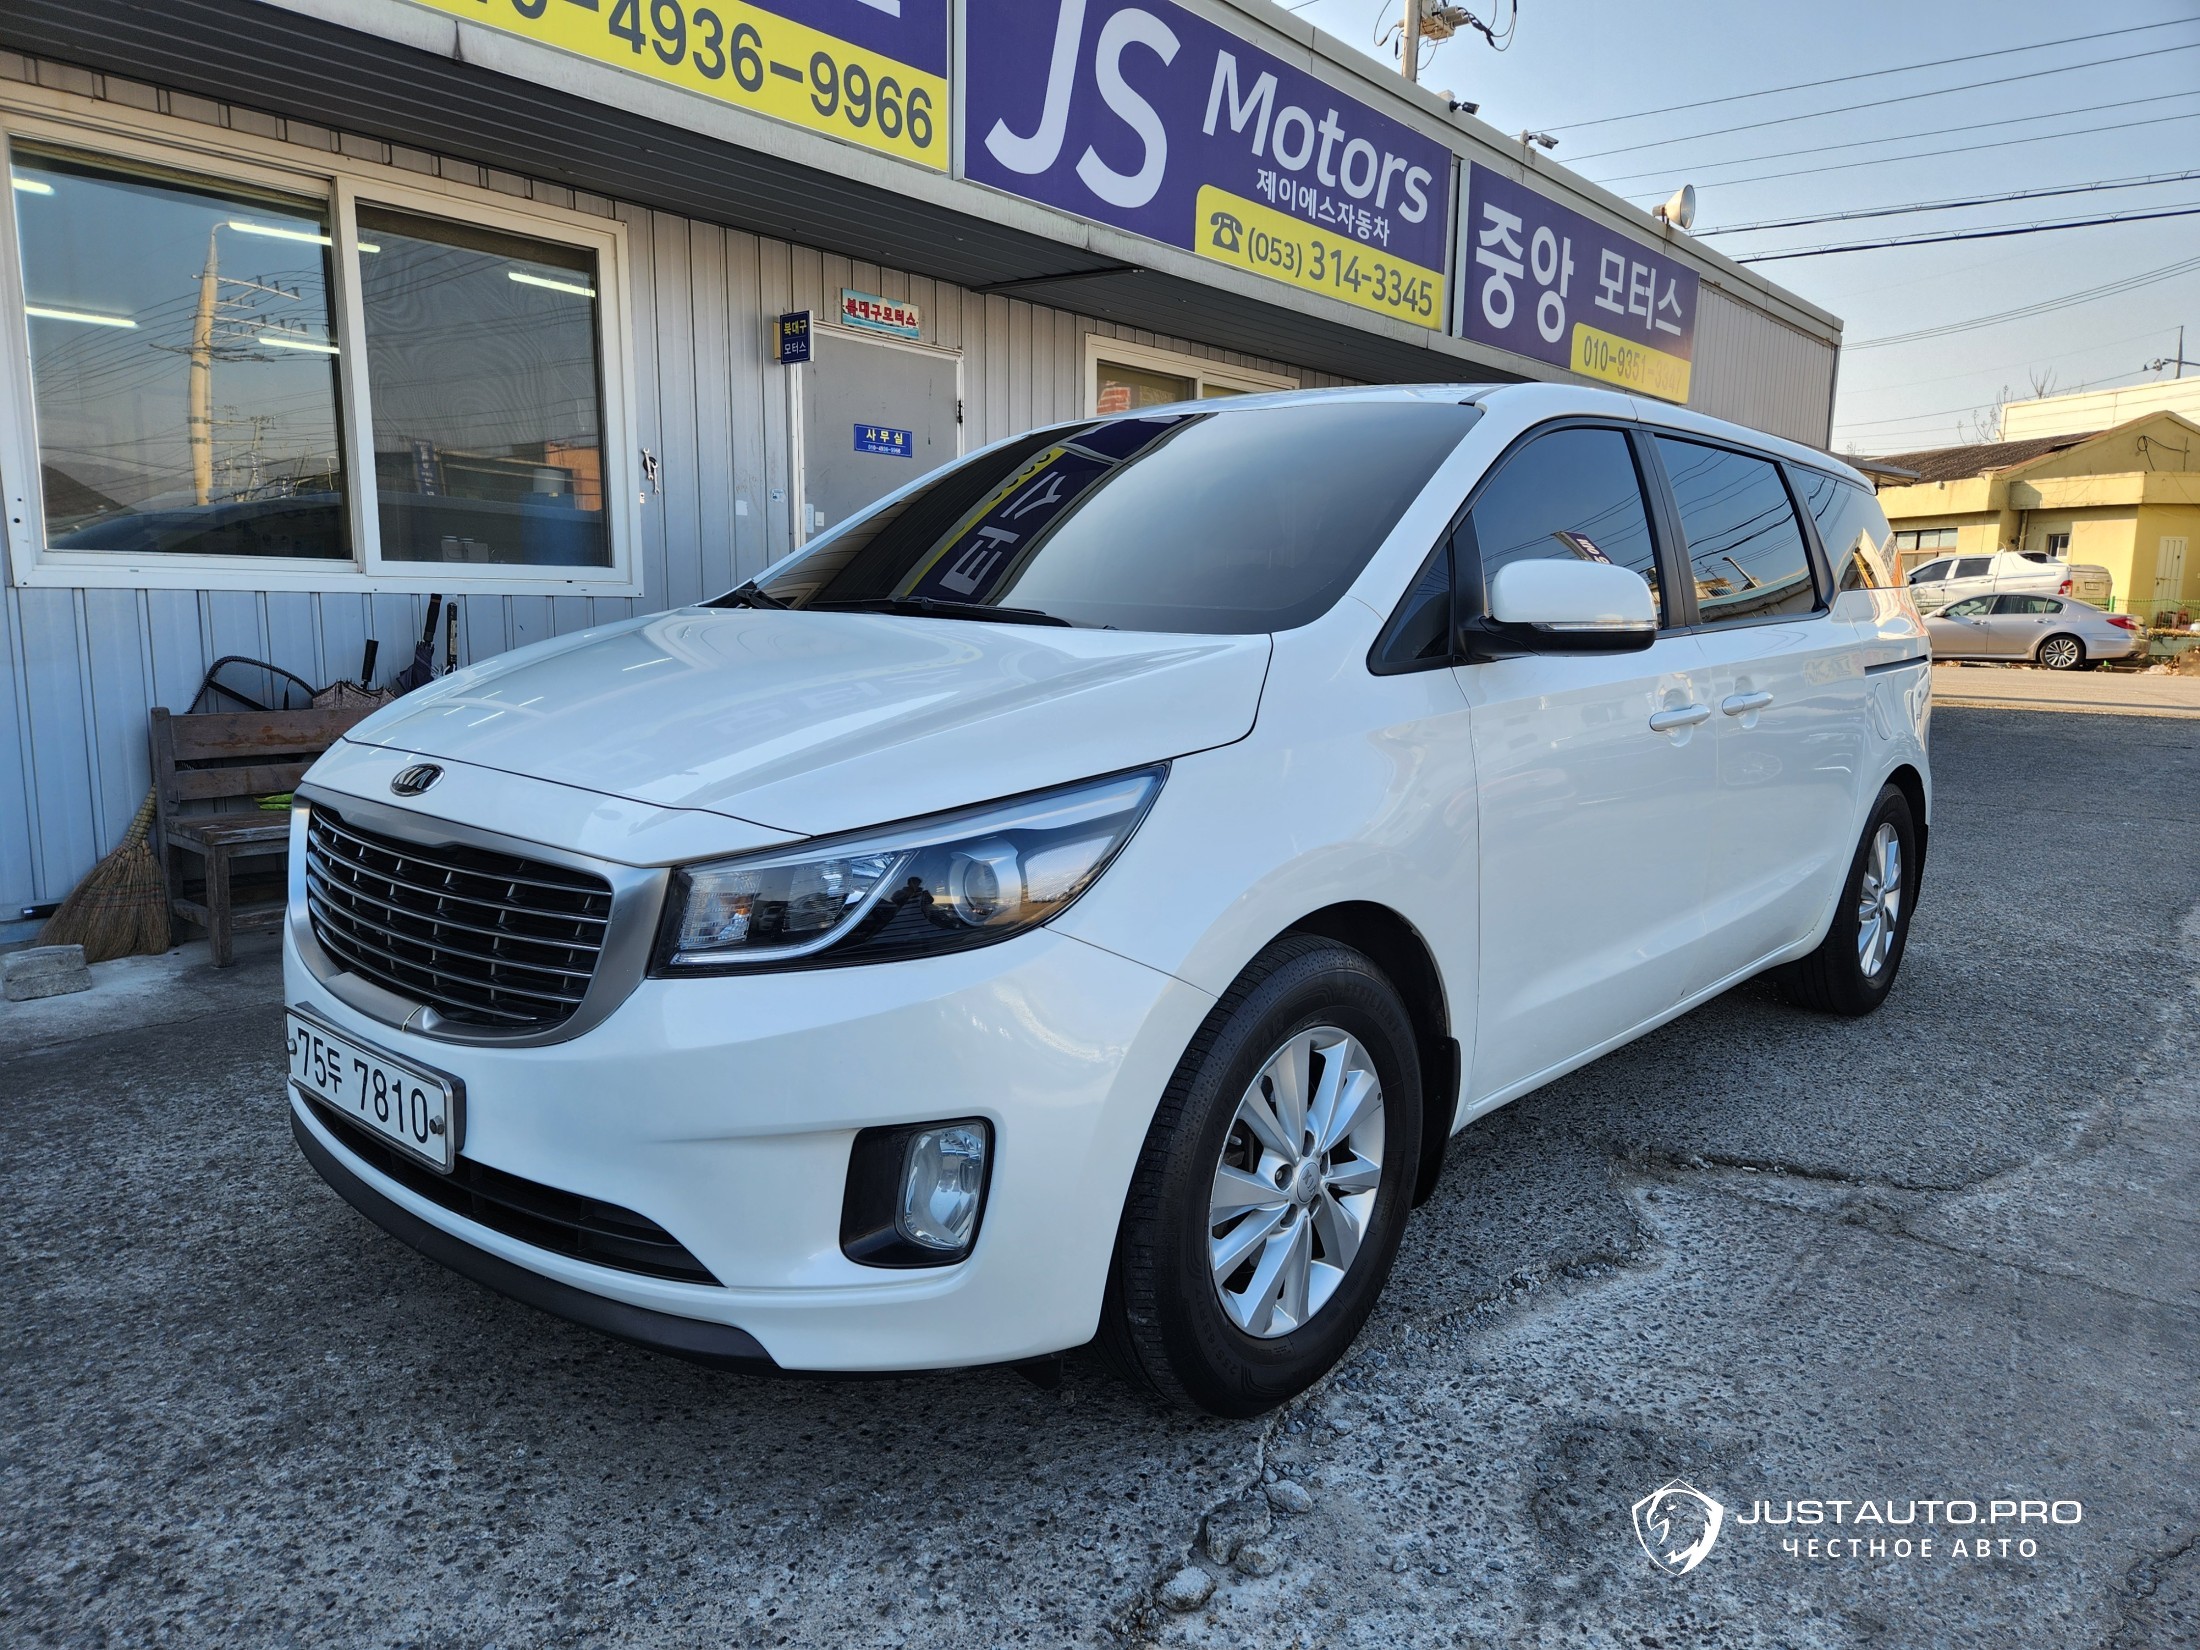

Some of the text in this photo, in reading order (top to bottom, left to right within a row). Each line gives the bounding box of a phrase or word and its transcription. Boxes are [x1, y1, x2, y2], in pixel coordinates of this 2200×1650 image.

[477, 0, 933, 148] -4936-9966
[984, 0, 1433, 224] JS Motors
[1256, 168, 1390, 247] 제이에스자동차
[845, 297, 917, 326] 북대구모터스
[1248, 227, 1433, 317] (053) 314-3345
[1475, 202, 1683, 343] 중앙 모터스
[783, 319, 807, 336] 북대구
[784, 341, 807, 355] 모터스
[298, 1027, 429, 1144] 75두 7810
